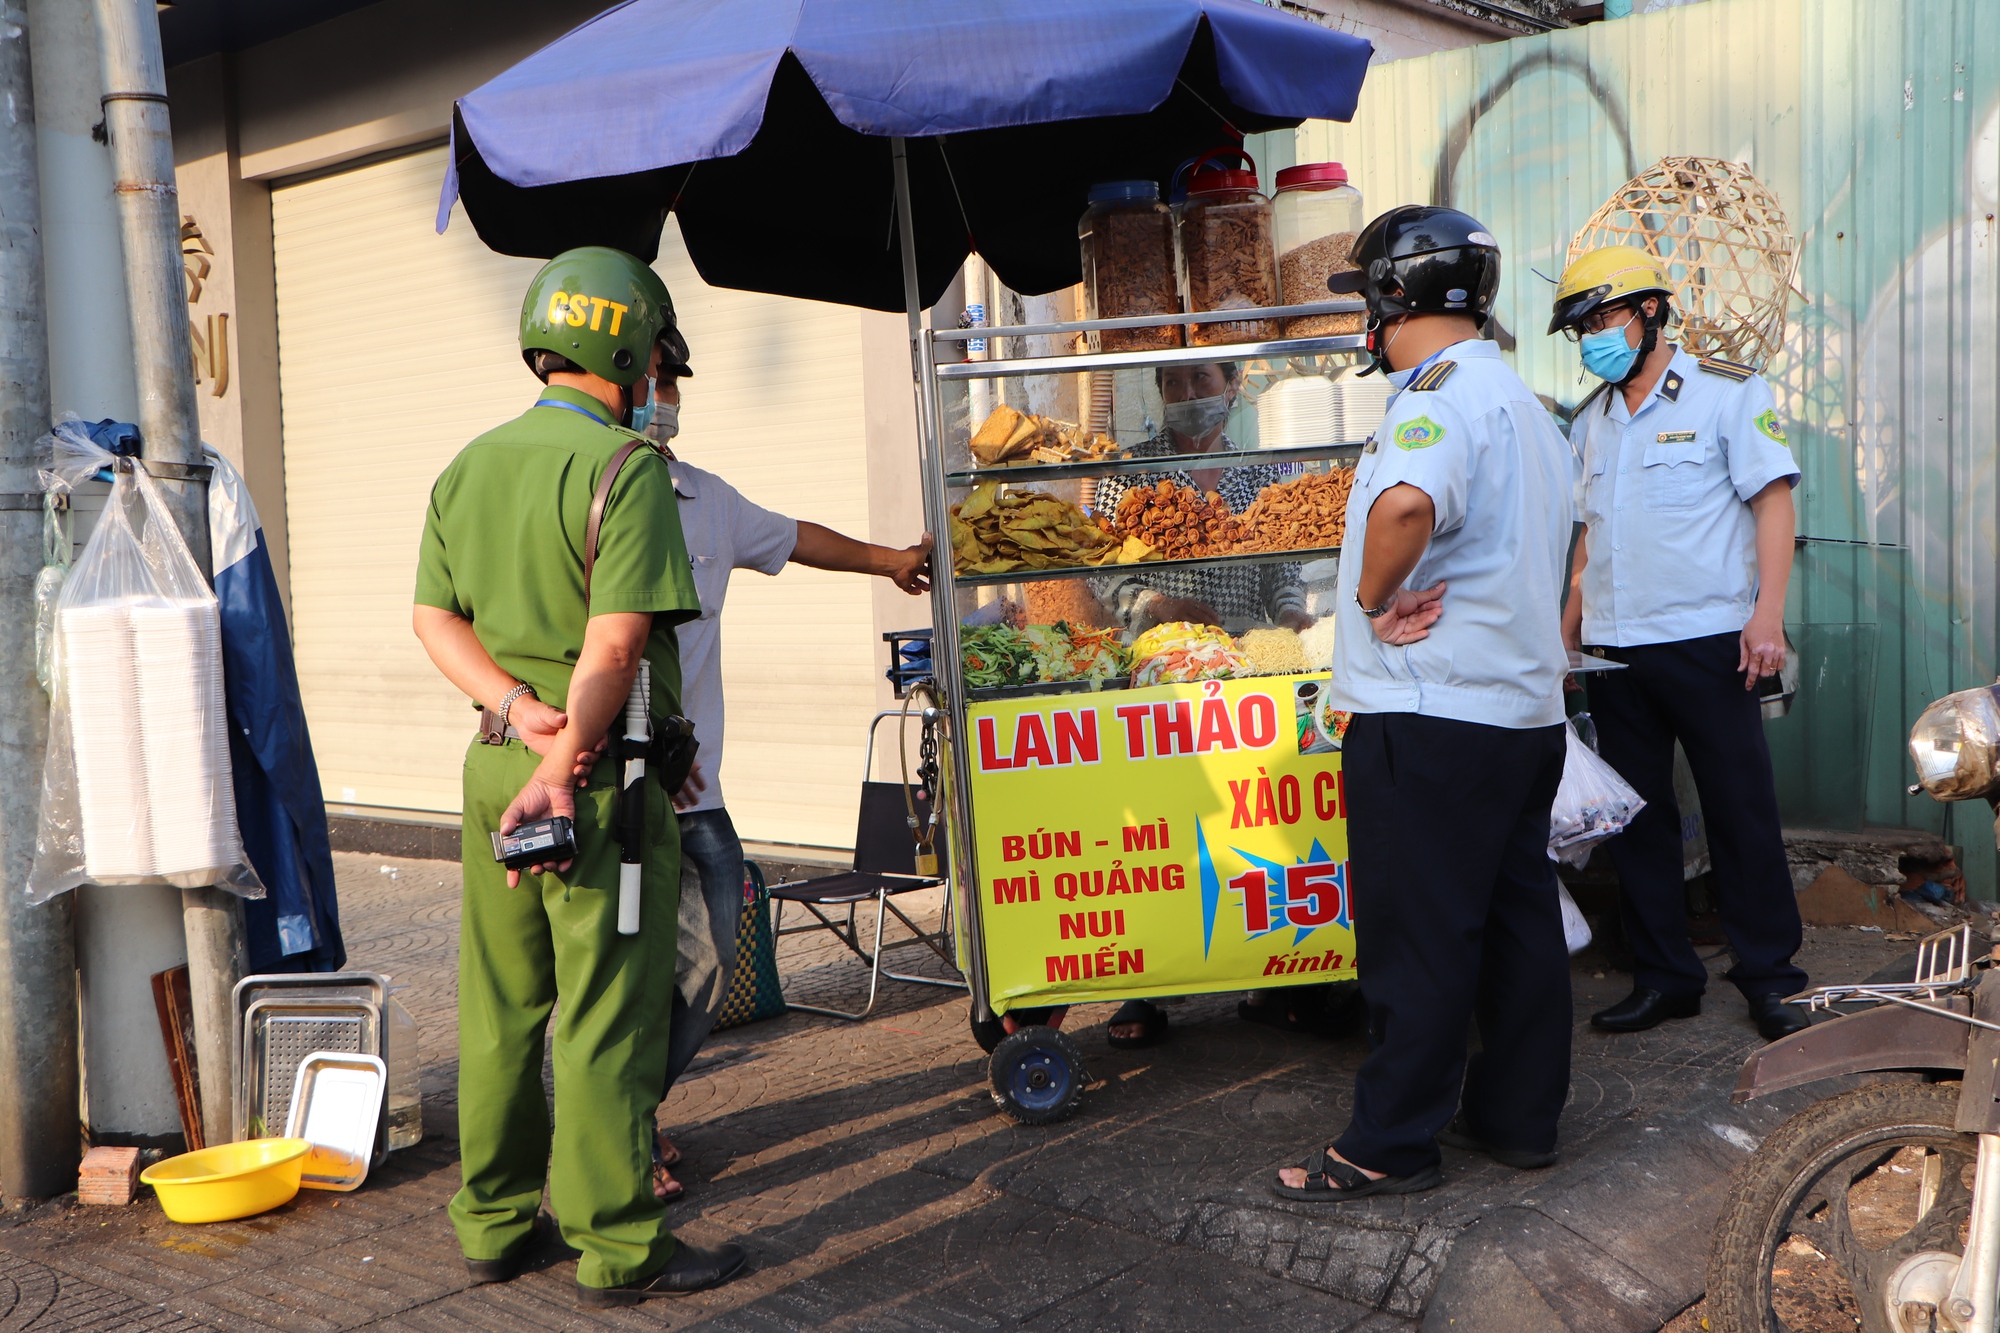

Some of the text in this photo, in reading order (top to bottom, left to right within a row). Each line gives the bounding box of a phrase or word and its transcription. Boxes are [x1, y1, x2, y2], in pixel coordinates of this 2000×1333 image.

[547, 291, 629, 336] CSTT
[976, 680, 1277, 772] LAN THẢO
[1228, 766, 1302, 830] XÀO
[1002, 827, 1082, 862] BÚN
[1122, 818, 1170, 852] MÌ
[993, 860, 1186, 905] MÌ QUẢNG
[1059, 909, 1126, 940] NUI
[1045, 943, 1145, 983] MIẾN
